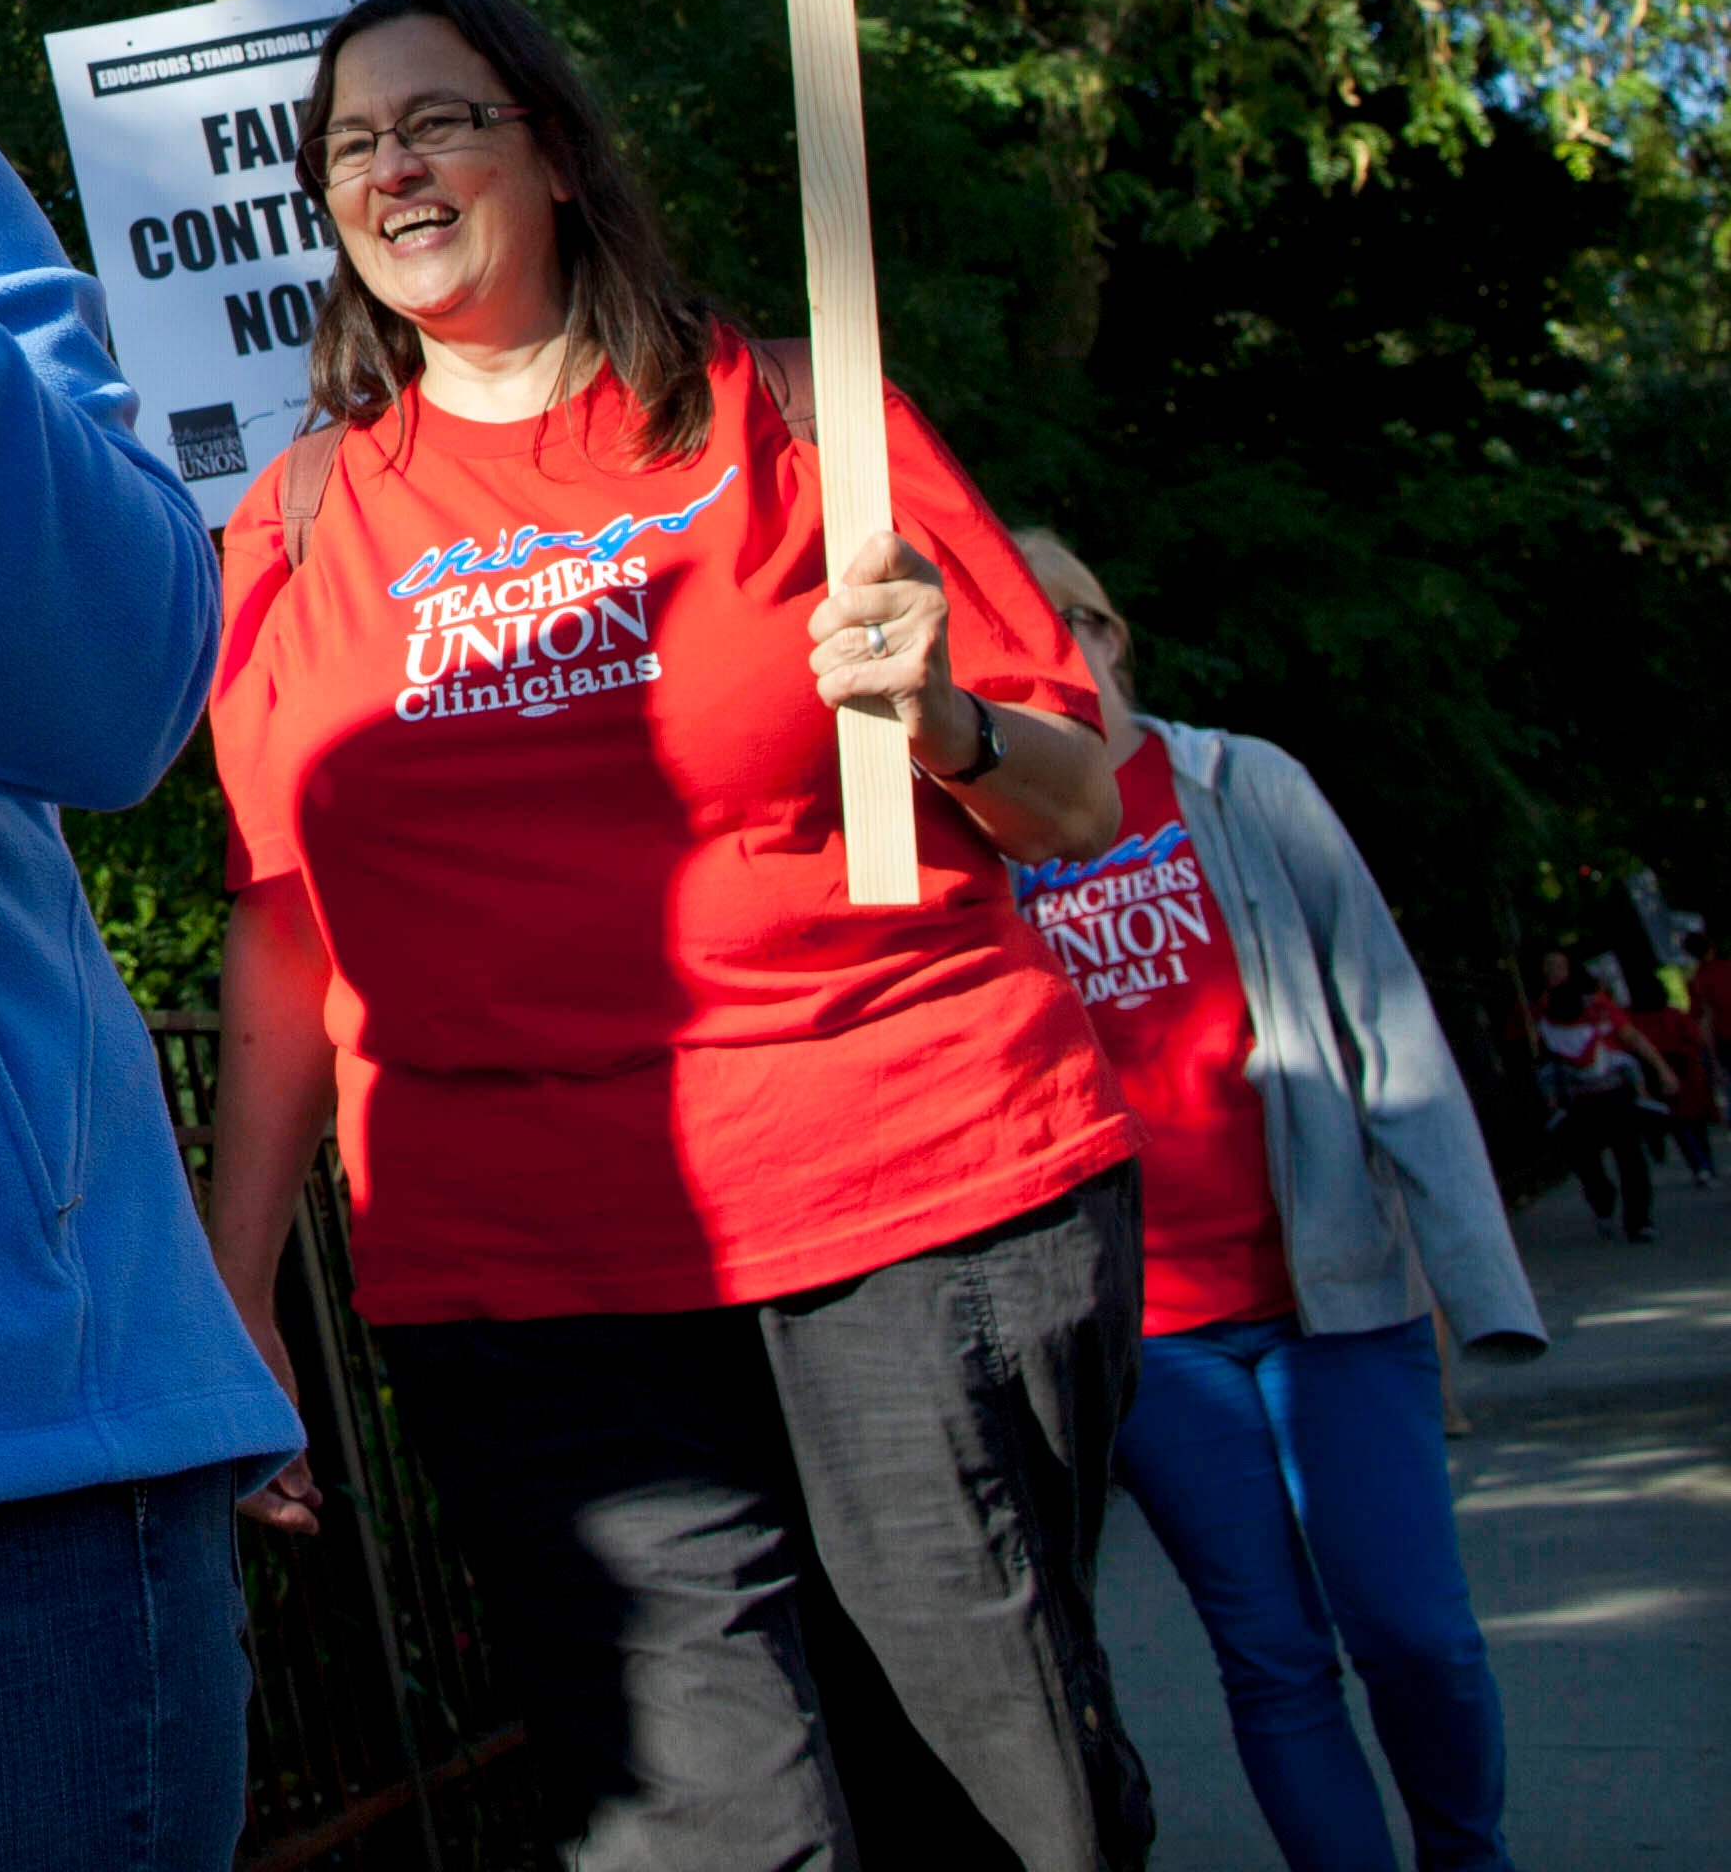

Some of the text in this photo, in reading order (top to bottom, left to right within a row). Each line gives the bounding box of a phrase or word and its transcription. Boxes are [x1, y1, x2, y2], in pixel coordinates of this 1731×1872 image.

[96, 55, 191, 90] EDUCATORS
[190, 43, 245, 73] STAND
[245, 31, 311, 61] STRONG
[129, 190, 339, 280] CONTR
[224, 279, 329, 357] NO
[179, 453, 246, 479] UNION
[413, 556, 649, 632] TEACHERS
[405, 590, 650, 686] UNION
[394, 651, 663, 723] Clinicians
[1023, 856, 1200, 928] EACHERS
[1072, 958, 1168, 1006] LOCAL
[1166, 953, 1190, 984] 1
